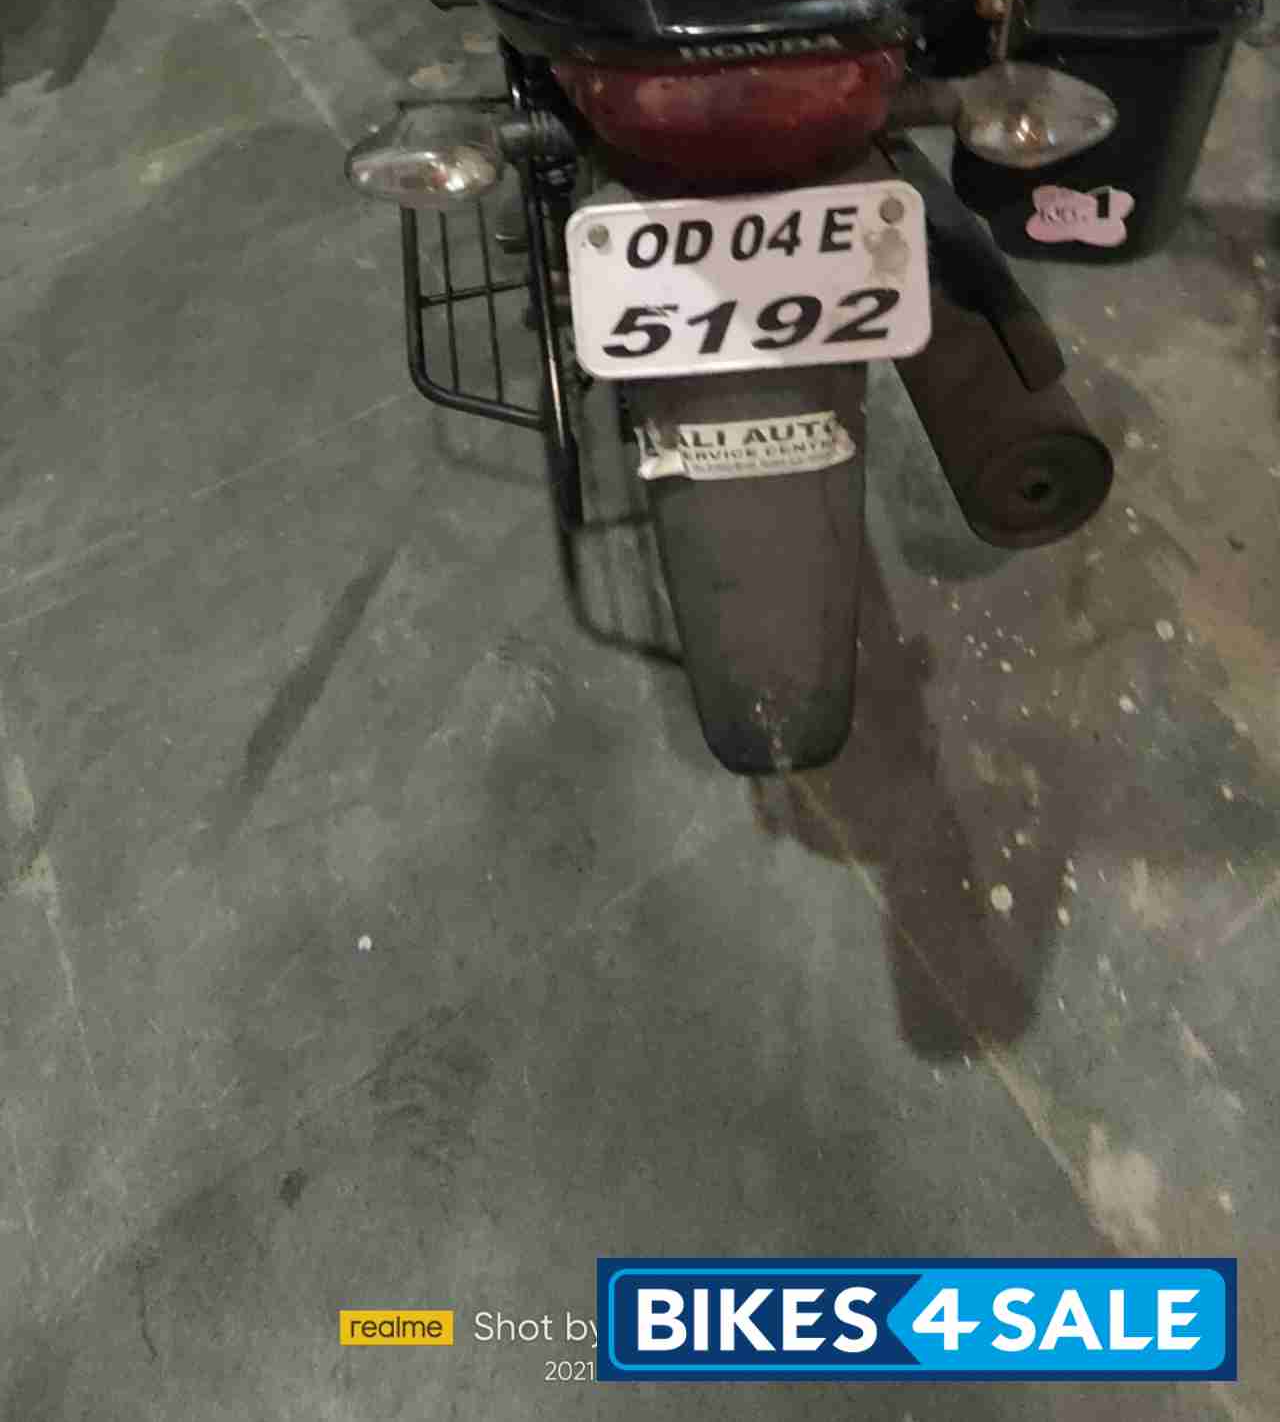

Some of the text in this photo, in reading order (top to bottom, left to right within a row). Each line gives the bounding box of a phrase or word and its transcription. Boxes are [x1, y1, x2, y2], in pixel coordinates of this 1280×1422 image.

[679, 33, 843, 60] HONDA
[626, 206, 859, 269] OD 04 E
[602, 287, 900, 358] 5192
